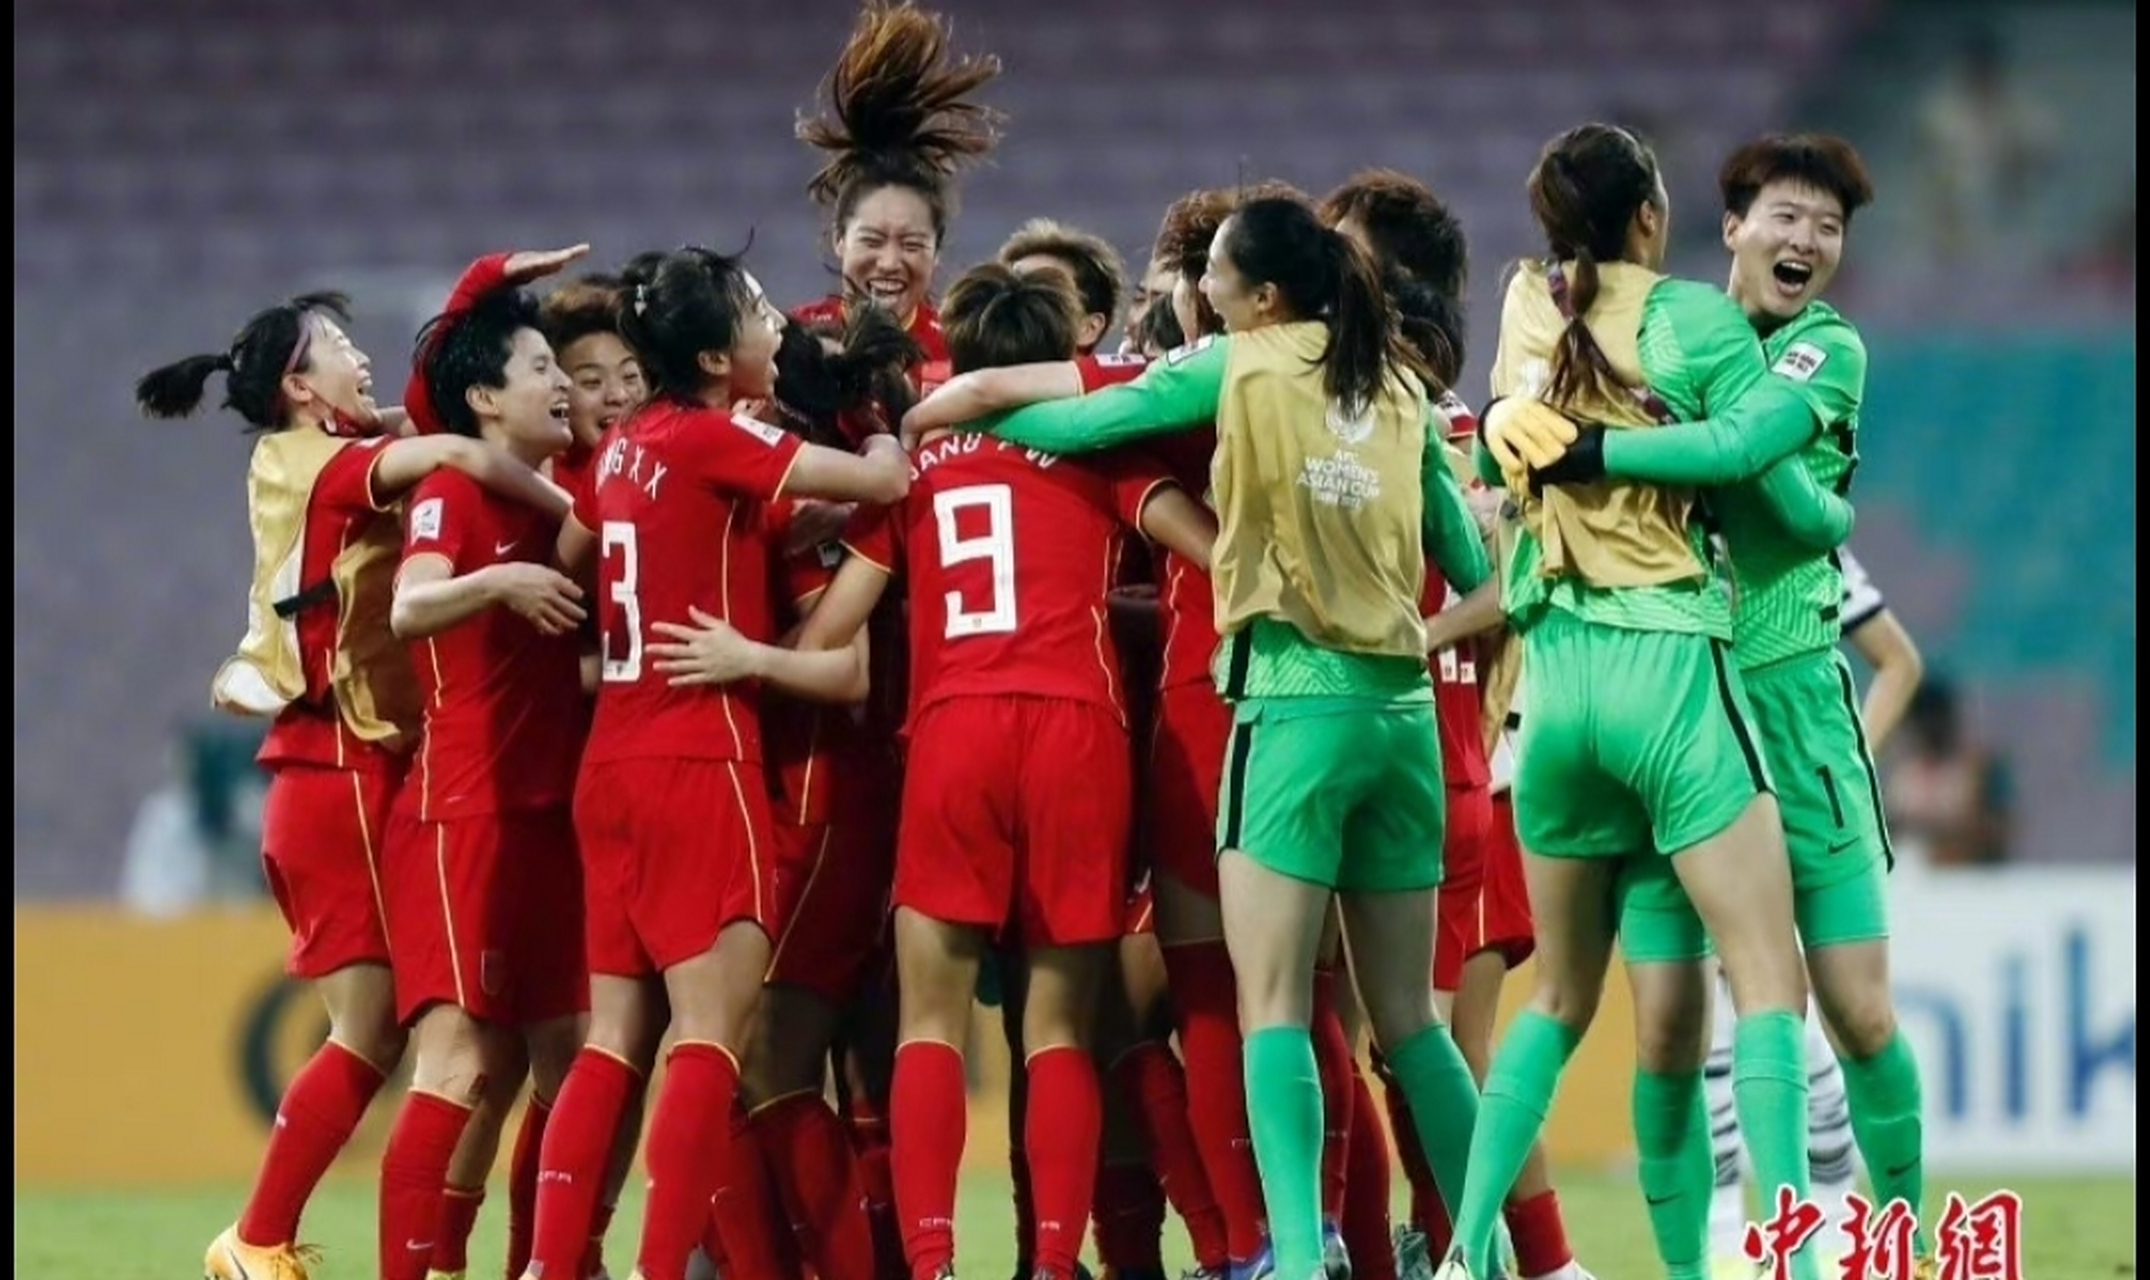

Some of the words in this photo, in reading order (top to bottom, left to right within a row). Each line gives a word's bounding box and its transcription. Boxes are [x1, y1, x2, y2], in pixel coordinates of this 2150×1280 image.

[1294, 470, 1349, 494] ASIAN
[603, 520, 642, 681] 3
[933, 483, 1017, 640] 9
[1815, 763, 1844, 830] 1
